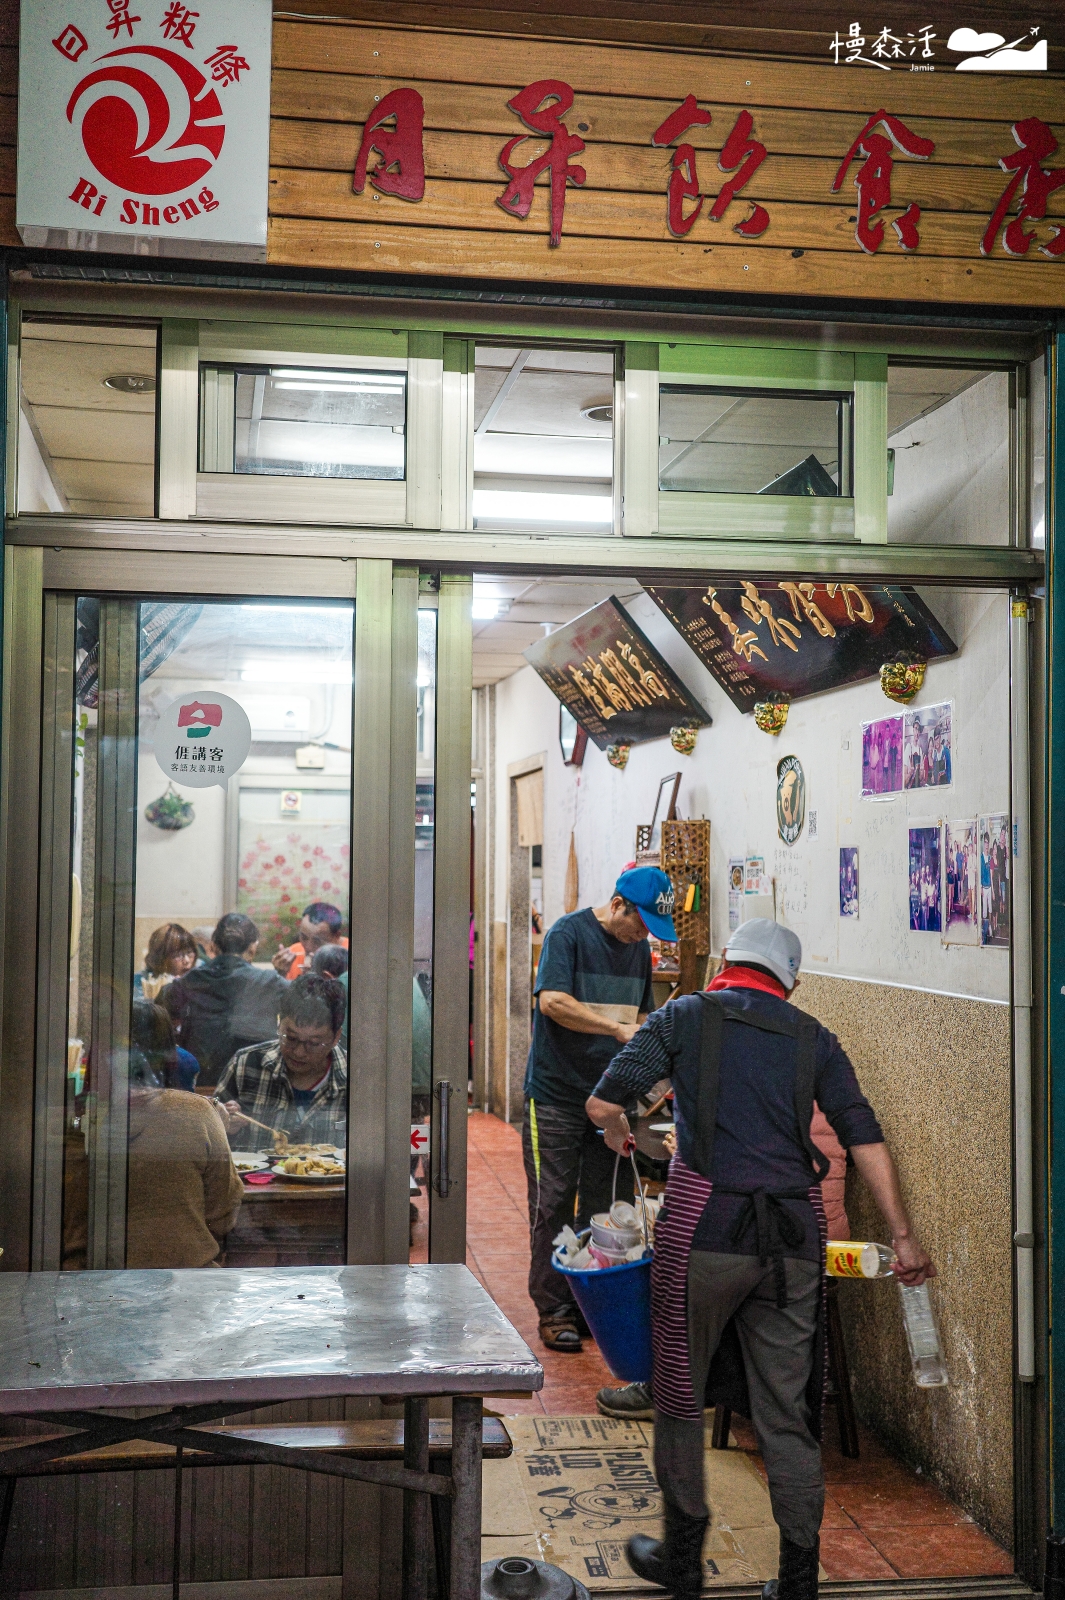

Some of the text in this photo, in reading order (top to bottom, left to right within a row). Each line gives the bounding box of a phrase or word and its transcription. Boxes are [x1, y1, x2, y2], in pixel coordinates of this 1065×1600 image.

[68, 177, 220, 226] Ri Sheng
[171, 764, 225, 773] 客語友善環境
[655, 891, 675, 904] Aud
[559, 1453, 602, 1468] LID
